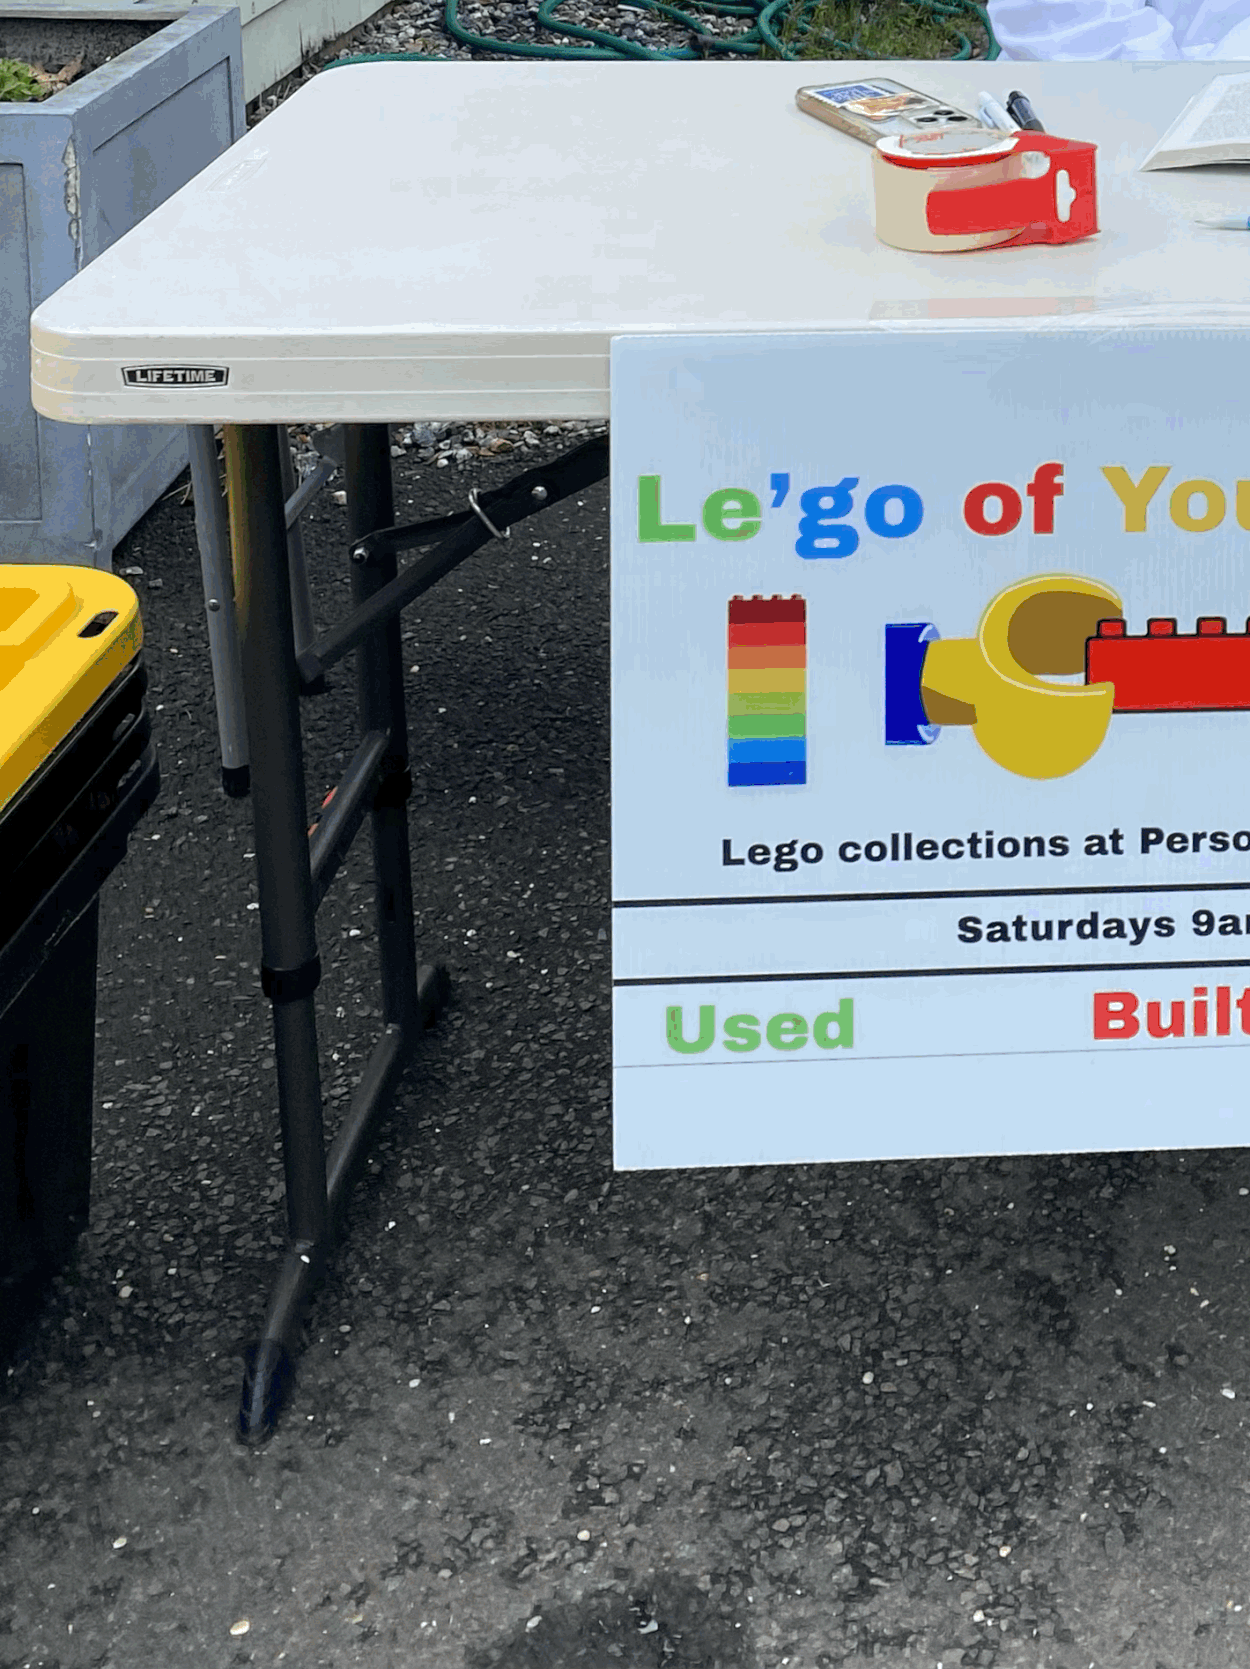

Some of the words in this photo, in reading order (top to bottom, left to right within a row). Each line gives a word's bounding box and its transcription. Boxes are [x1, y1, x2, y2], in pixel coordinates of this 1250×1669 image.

[136, 370, 216, 382] LIFETIME
[963, 463, 1064, 535] of
[722, 838, 824, 873] Lego
[838, 830, 1070, 864] collections
[1084, 828, 1124, 856] at
[957, 911, 1175, 946] Saturdays
[665, 998, 855, 1054] Used
